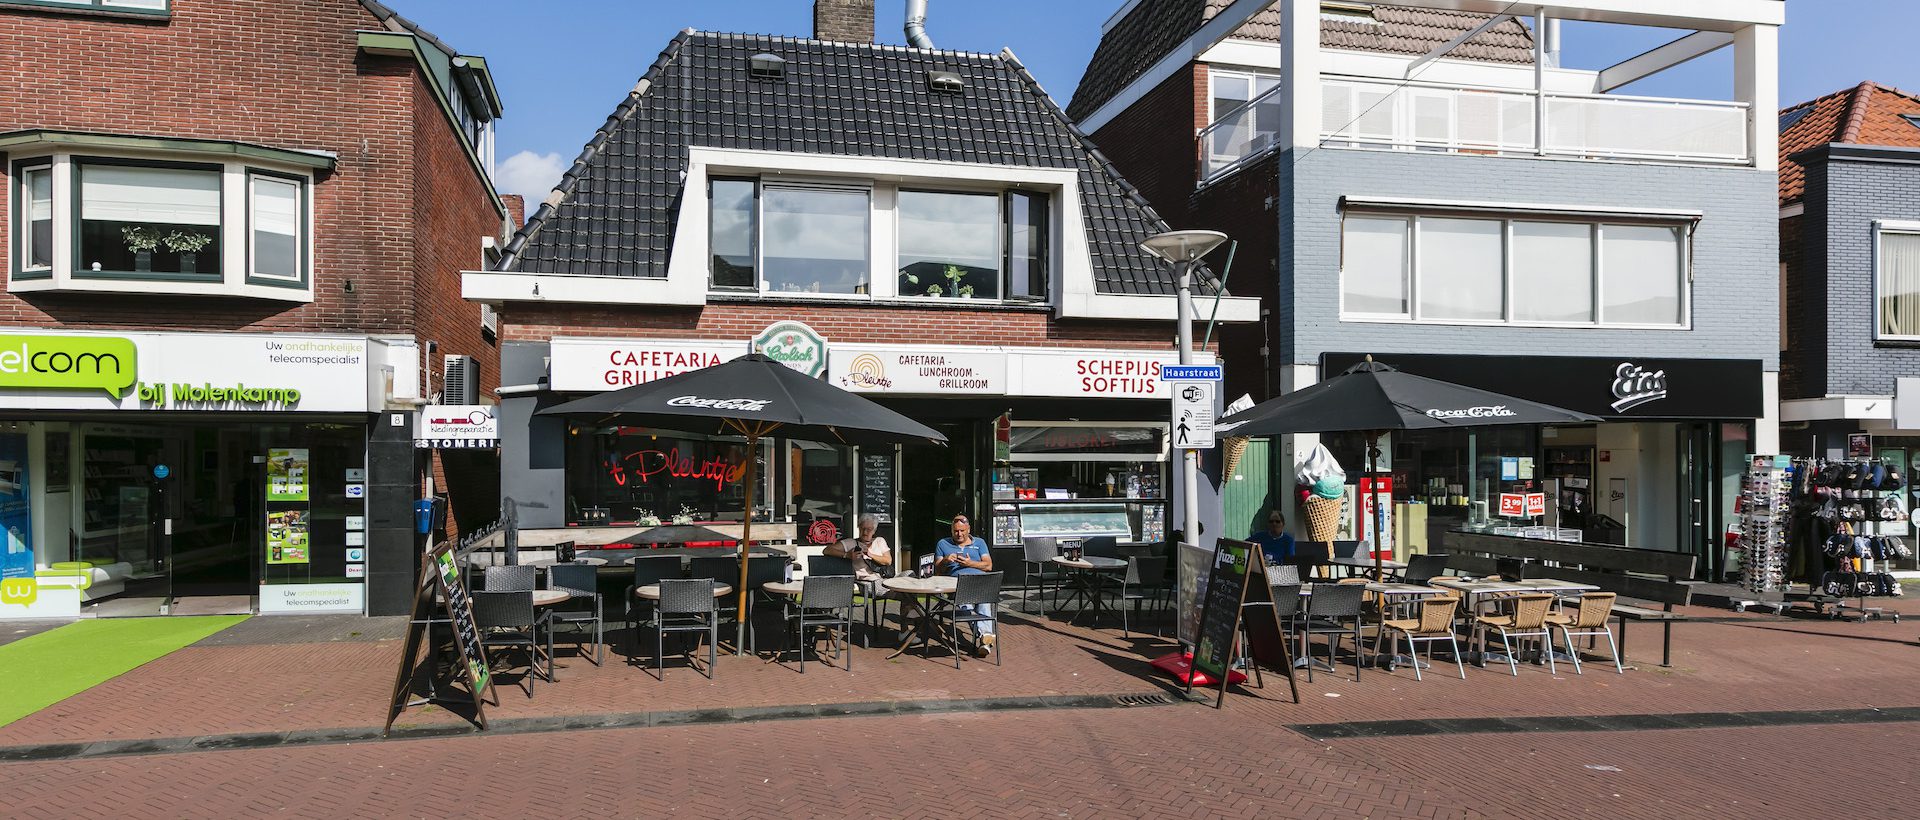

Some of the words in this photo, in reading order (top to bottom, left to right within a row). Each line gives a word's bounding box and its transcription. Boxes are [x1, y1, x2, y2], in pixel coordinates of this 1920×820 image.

[265, 341, 283, 351] Uw
[285, 341, 363, 354] onafhankelijke
[766, 344, 814, 361] Grolsch
[269, 354, 360, 366] telecomspecialist
[610, 351, 721, 368] CAFETARIA
[899, 355, 945, 366] CAFETARIA
[919, 367, 973, 377] LUNCHROOM
[1077, 360, 1160, 375] SCHEPIJS
[1165, 368, 1219, 378] Haarstraat
[849, 372, 892, 390] Pleintje
[939, 378, 988, 389] GRILLROOM
[1082, 377, 1155, 393] SOFTIJS
[1611, 362, 1667, 405] Etos
[138, 382, 166, 407] bij
[172, 382, 301, 407] Molenkamp
[394, 415, 401, 424] 8
[1503, 499, 1522, 509] 3.99
[1063, 541, 1082, 549] MENU
[921, 554, 934, 566] MENU
[1219, 549, 1235, 564] fuze
[286, 599, 349, 609] telecomspecialist
